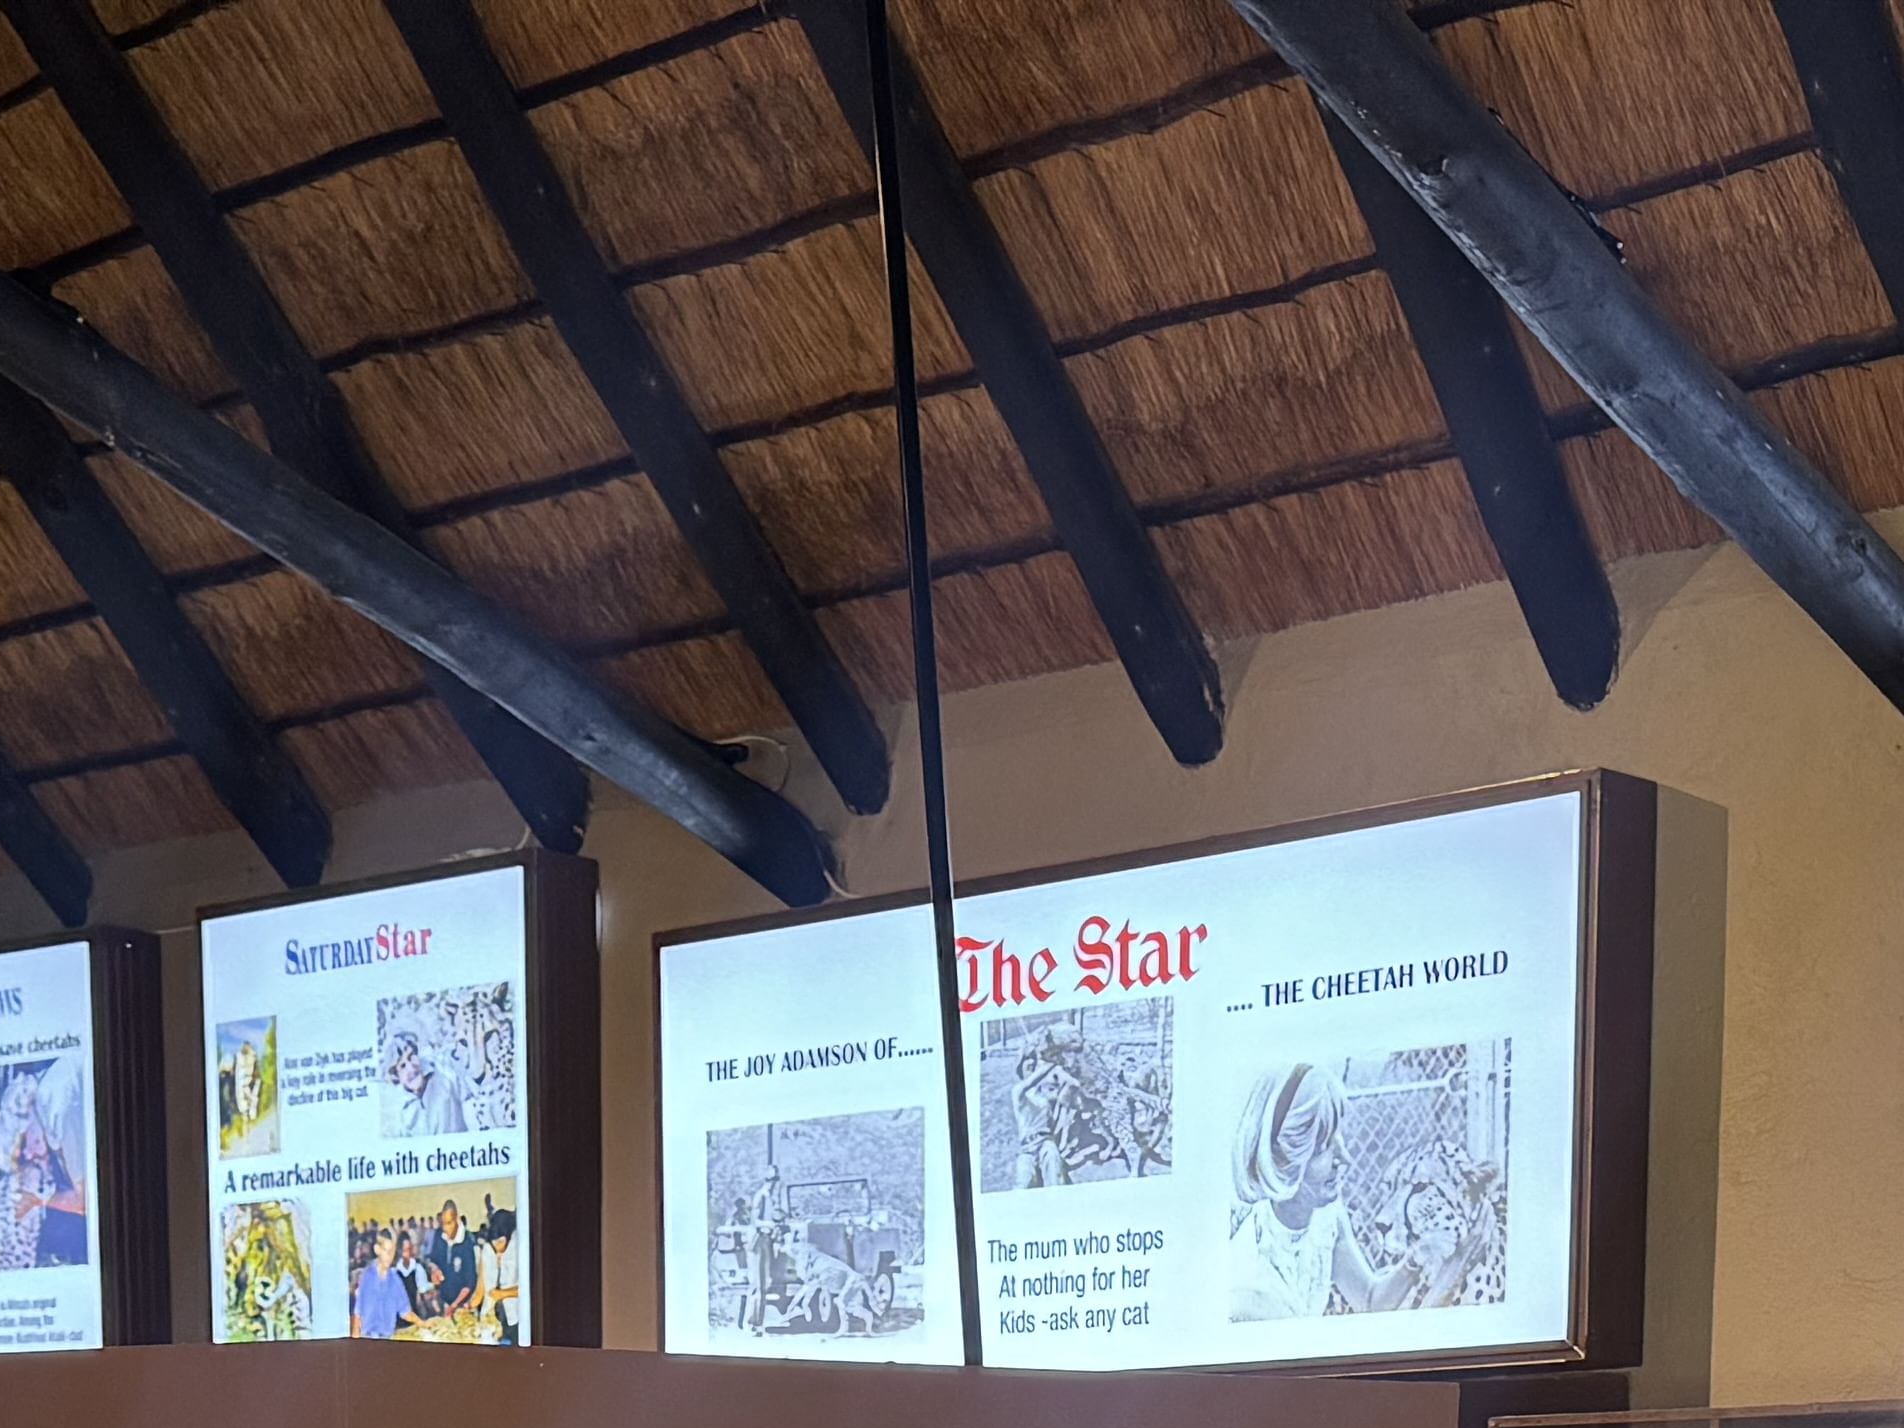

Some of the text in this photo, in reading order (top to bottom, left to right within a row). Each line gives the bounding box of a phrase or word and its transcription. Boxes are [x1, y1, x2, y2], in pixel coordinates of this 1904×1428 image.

[957, 914, 1210, 1013] The Star
[1261, 979, 1304, 1007] THE
[1311, 963, 1413, 1000] CHEETAH
[1423, 950, 1508, 984] WORLD
[27, 1032, 81, 1053] cheetahs
[705, 1058, 739, 1082] THE
[743, 1053, 775, 1077] JOY
[780, 1041, 866, 1072] ADAMSON
[224, 1142, 510, 1193] A remarkable life with cheetahs
[987, 1228, 1163, 1263] The mum who stops
[998, 1264, 1150, 1298] At nothing for her
[1000, 1309, 1035, 1334] Kids
[1085, 1308, 1116, 1333] any
[1122, 1301, 1149, 1325] cat
